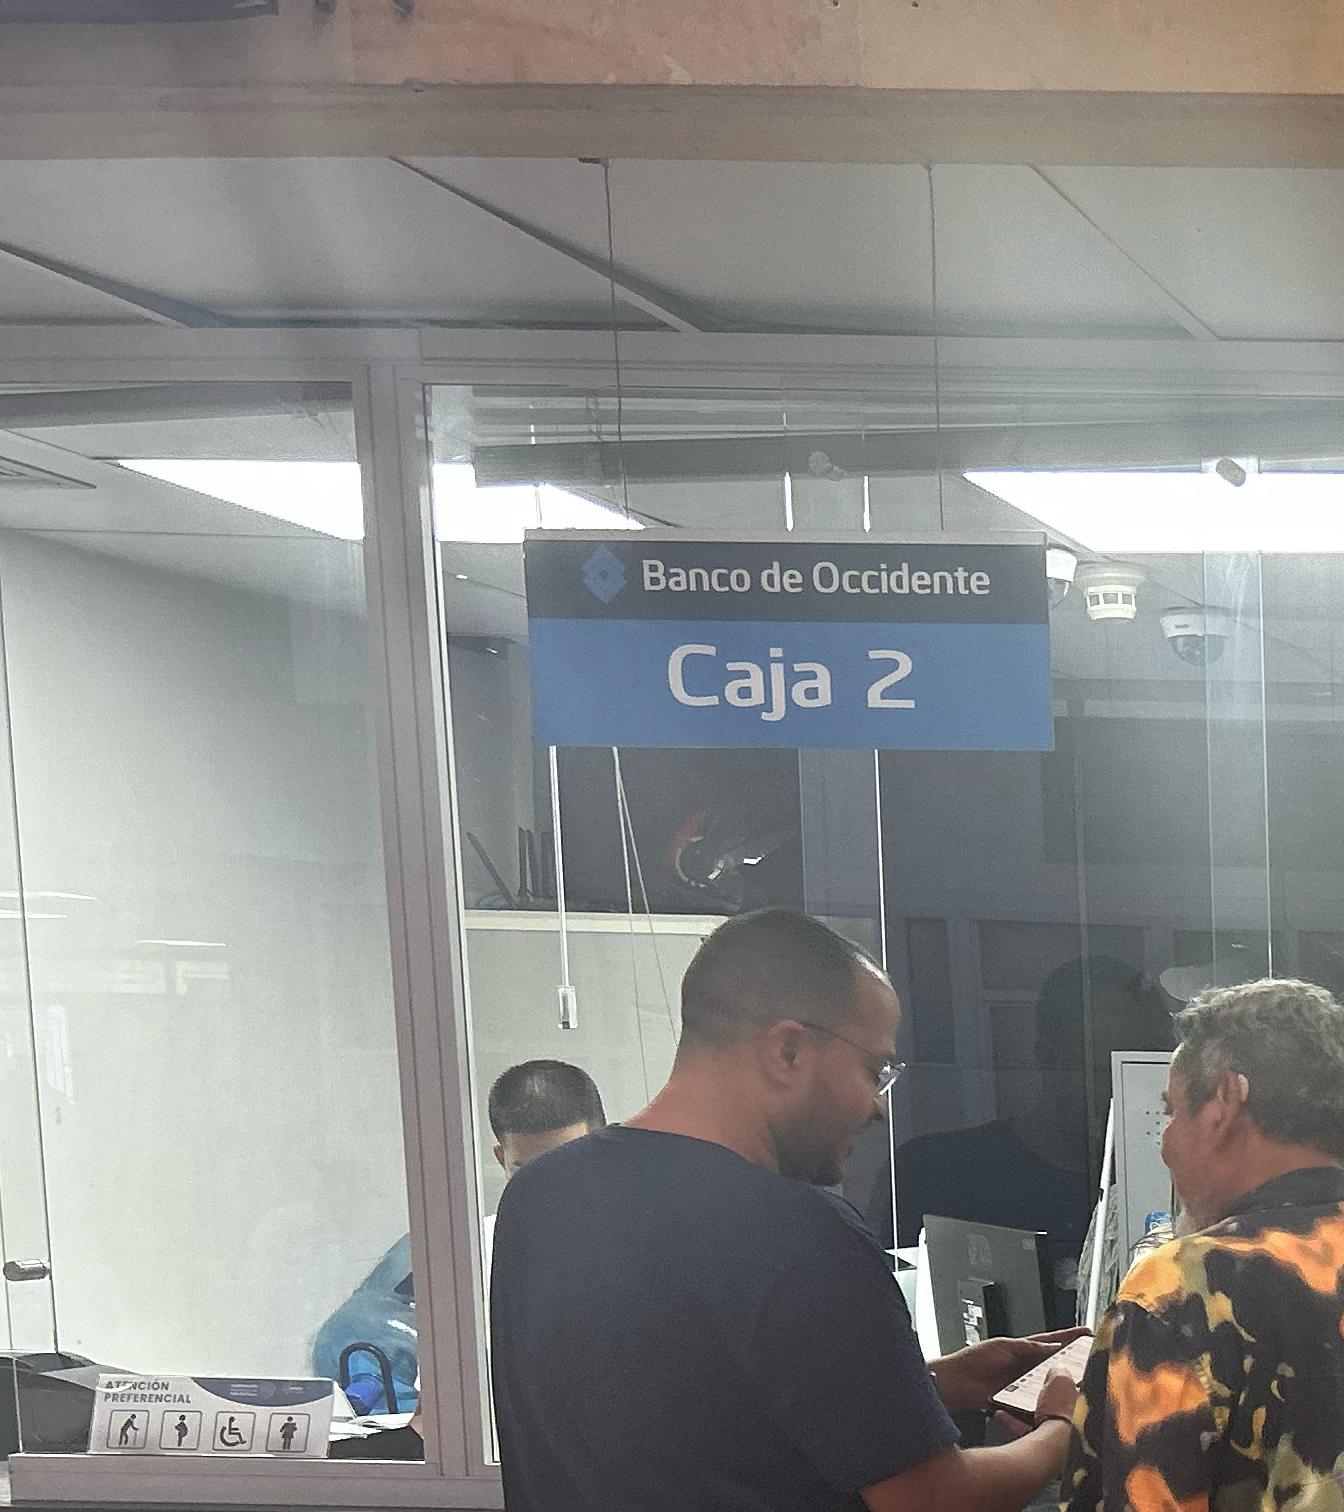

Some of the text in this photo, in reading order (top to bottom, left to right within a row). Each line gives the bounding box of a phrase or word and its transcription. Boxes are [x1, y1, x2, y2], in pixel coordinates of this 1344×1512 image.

[642, 559, 991, 595] Banco de Occidente
[668, 644, 916, 721] Caja 2
[104, 1392, 191, 1404] PREFERENCIAL
